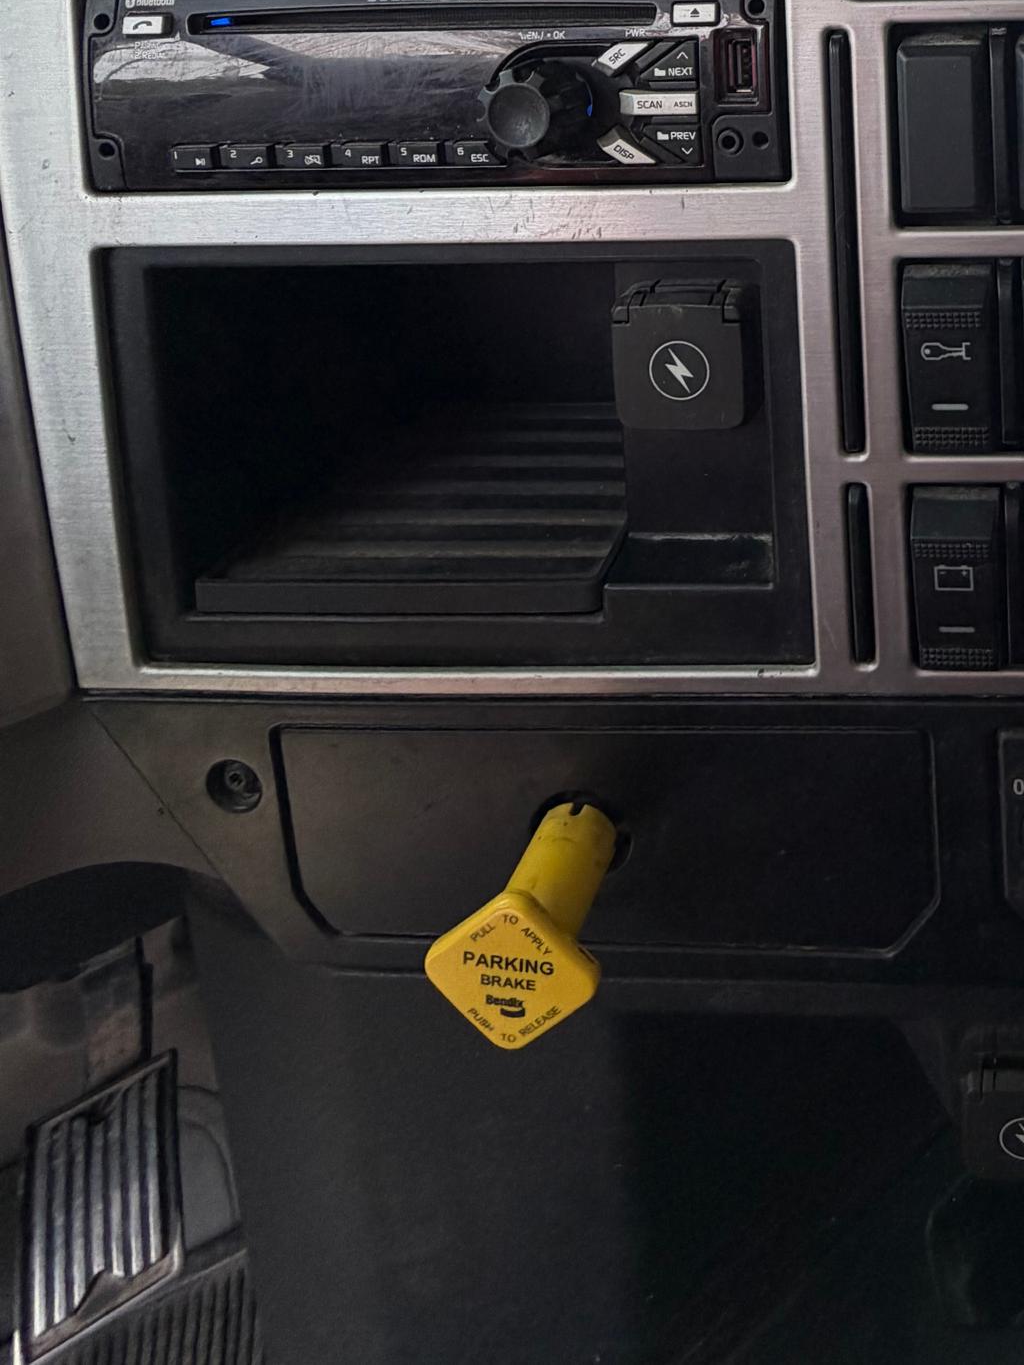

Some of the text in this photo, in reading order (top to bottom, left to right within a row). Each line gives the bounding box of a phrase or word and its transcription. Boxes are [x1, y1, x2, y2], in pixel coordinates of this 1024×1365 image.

[553, 30, 566, 40] OK
[625, 29, 645, 37] PWR
[608, 48, 626, 65] SRC
[668, 67, 693, 76] NEXT
[637, 100, 663, 109] SCAN
[670, 131, 696, 140] PREV
[230, 150, 237, 158] 2
[287, 150, 294, 158] 3
[344, 149, 351, 157] 4
[400, 147, 407, 156] 5
[457, 147, 464, 156] 6
[613, 144, 635, 160] DISP
[361, 155, 379, 165] RPT
[471, 154, 490, 163] ESC
[1013, 778, 1024, 795] 0
[470, 914, 552, 956] PULL TO APPLY
[462, 950, 554, 976] PARKING
[480, 974, 536, 991] BRAKE
[486, 995, 524, 1007] Bendix
[467, 1005, 562, 1043] PUSH TO RELEASE
